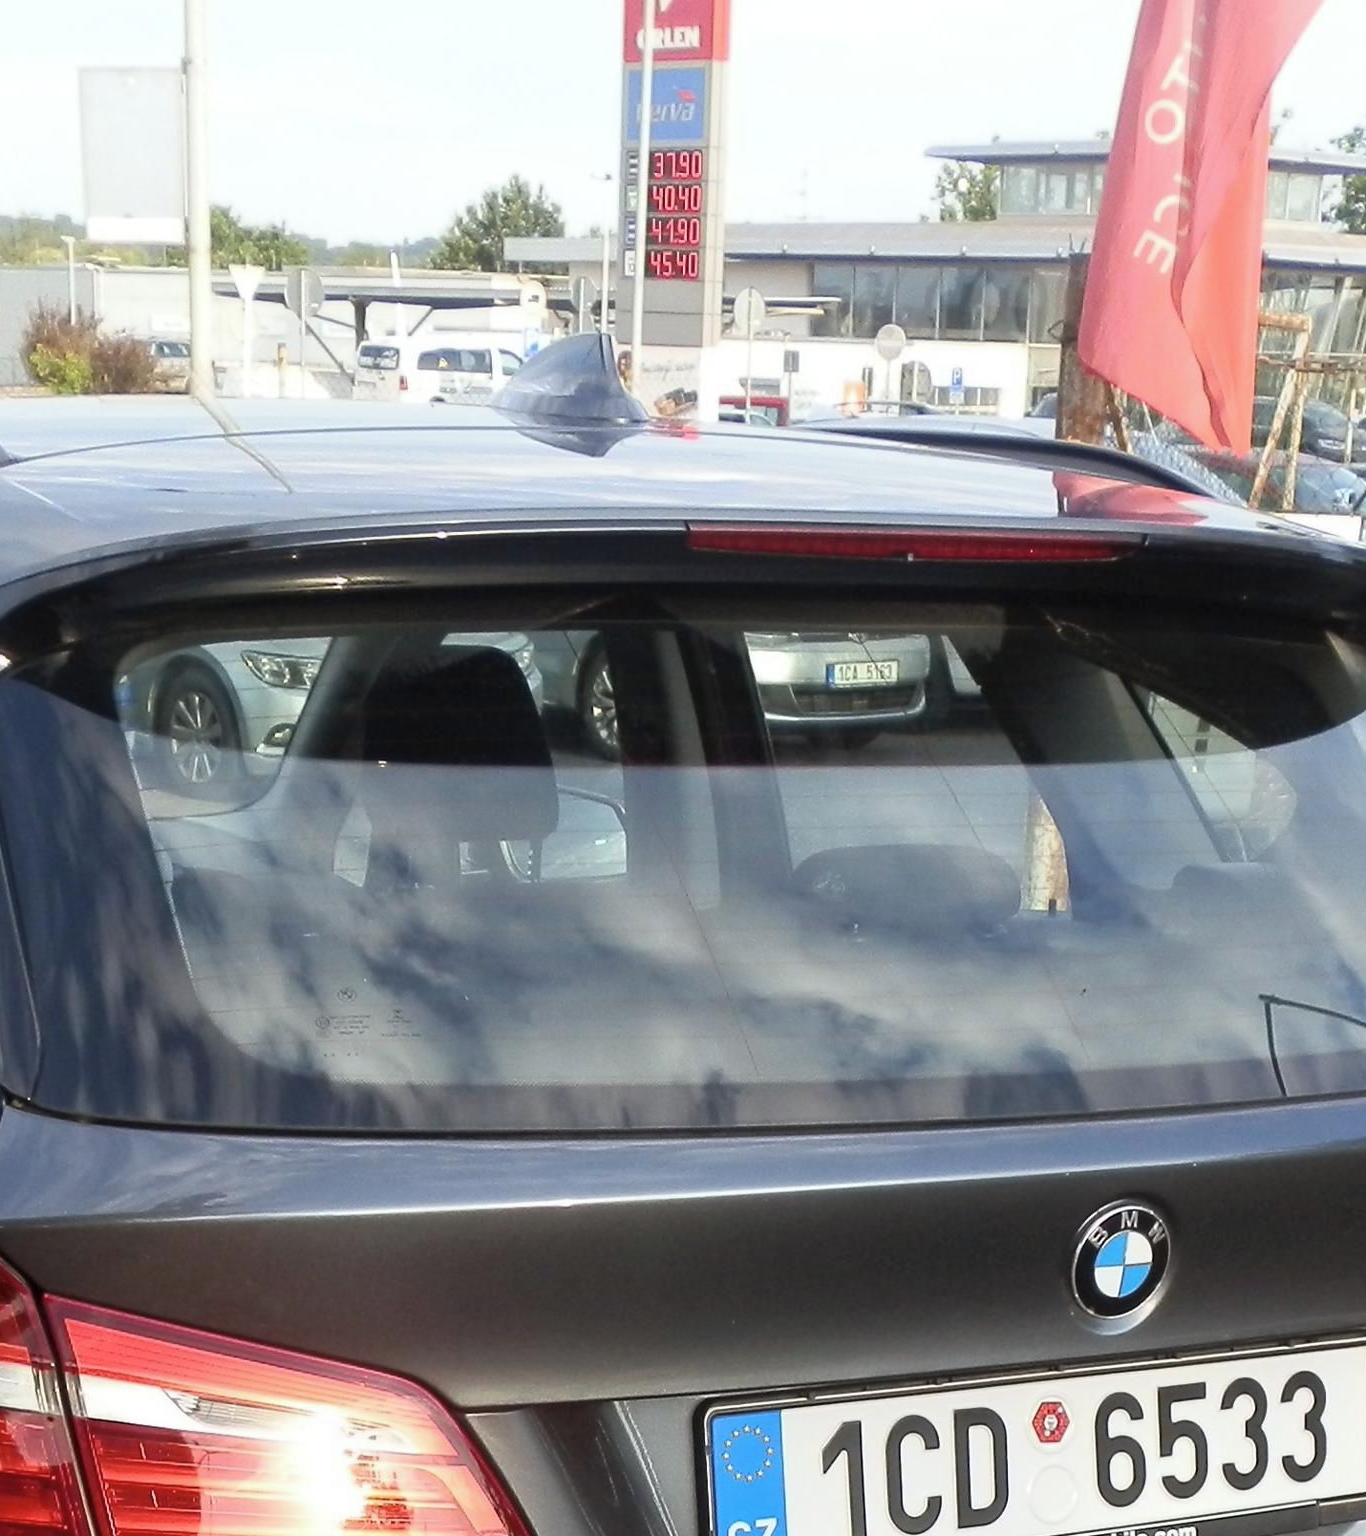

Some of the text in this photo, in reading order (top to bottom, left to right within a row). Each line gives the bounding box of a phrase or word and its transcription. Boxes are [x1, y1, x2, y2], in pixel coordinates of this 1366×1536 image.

[652, 185, 701, 211] 40.40
[1088, 1210, 1166, 1249] BMW
[1094, 1371, 1328, 1507] 6533
